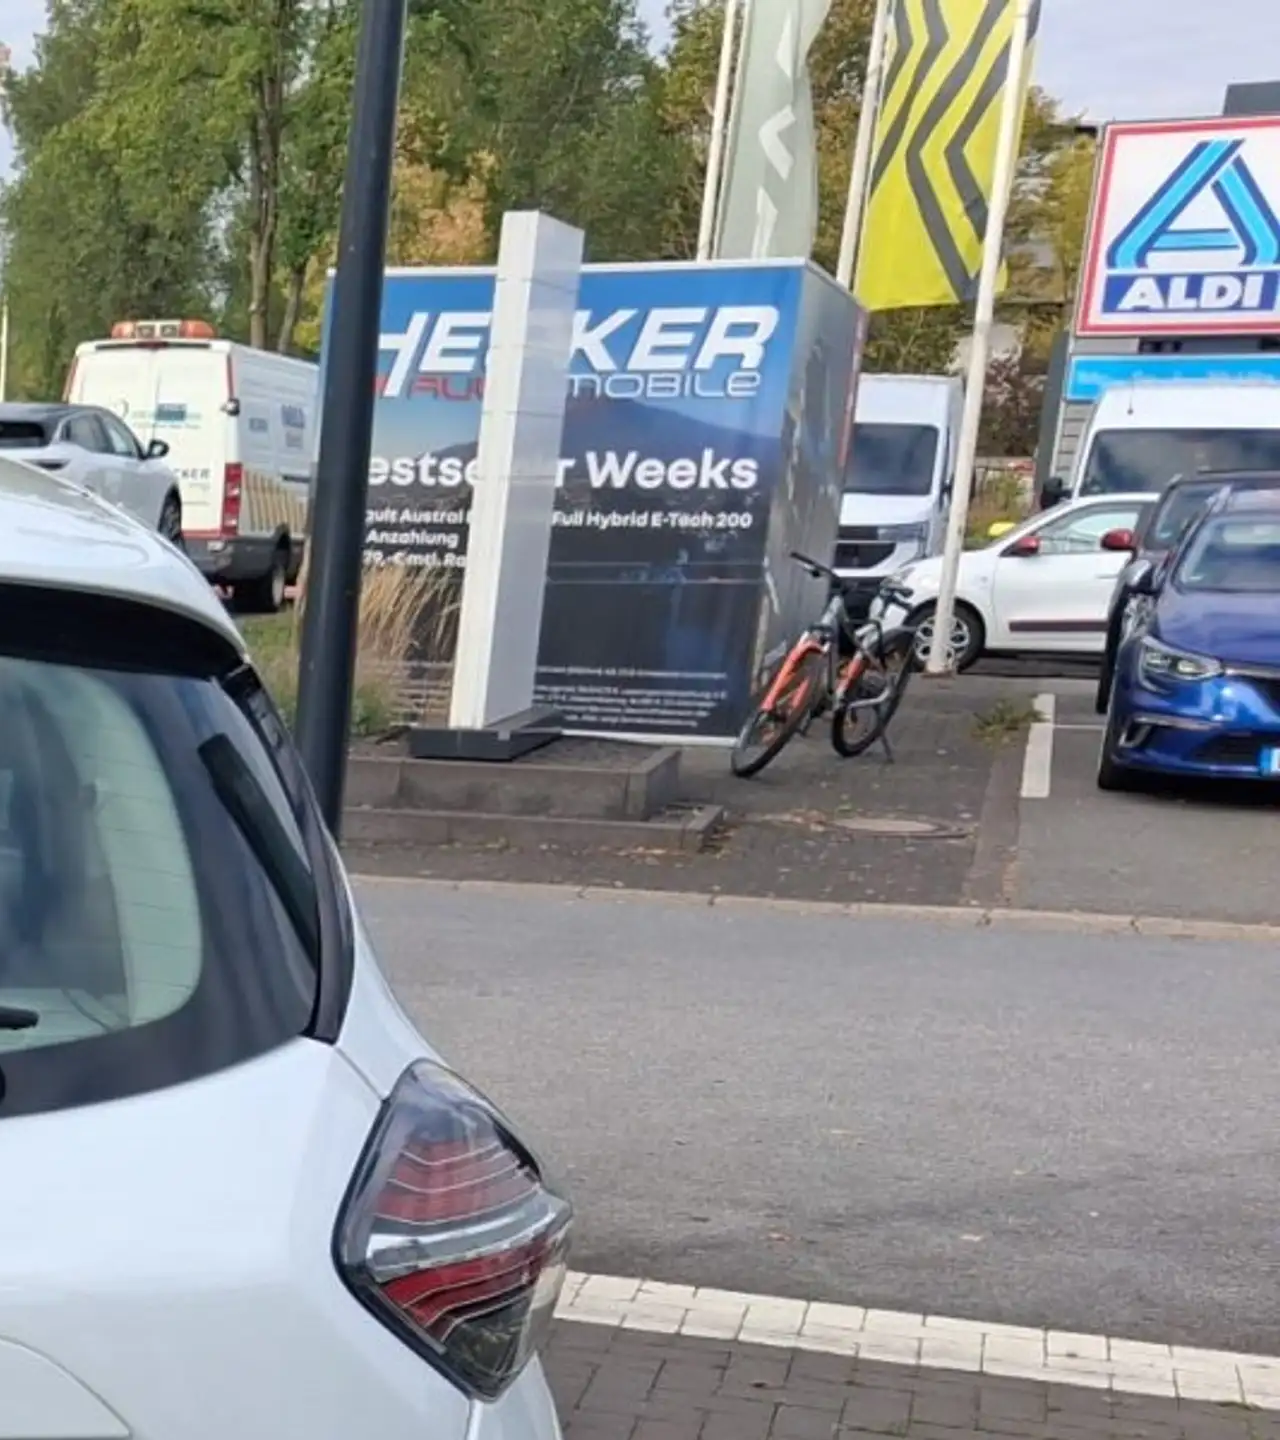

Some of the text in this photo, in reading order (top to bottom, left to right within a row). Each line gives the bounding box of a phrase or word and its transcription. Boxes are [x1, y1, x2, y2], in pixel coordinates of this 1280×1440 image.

[1117, 274, 1264, 310] ALDI
[378, 306, 780, 398] HEKER
[585, 447, 759, 490] Weeks
[399, 507, 464, 525] Austral
[552, 510, 585, 527] Full
[586, 510, 649, 530] Hybrid
[650, 510, 715, 529] E-Tech
[715, 511, 754, 529] 200
[365, 529, 459, 549] Anzahlung
